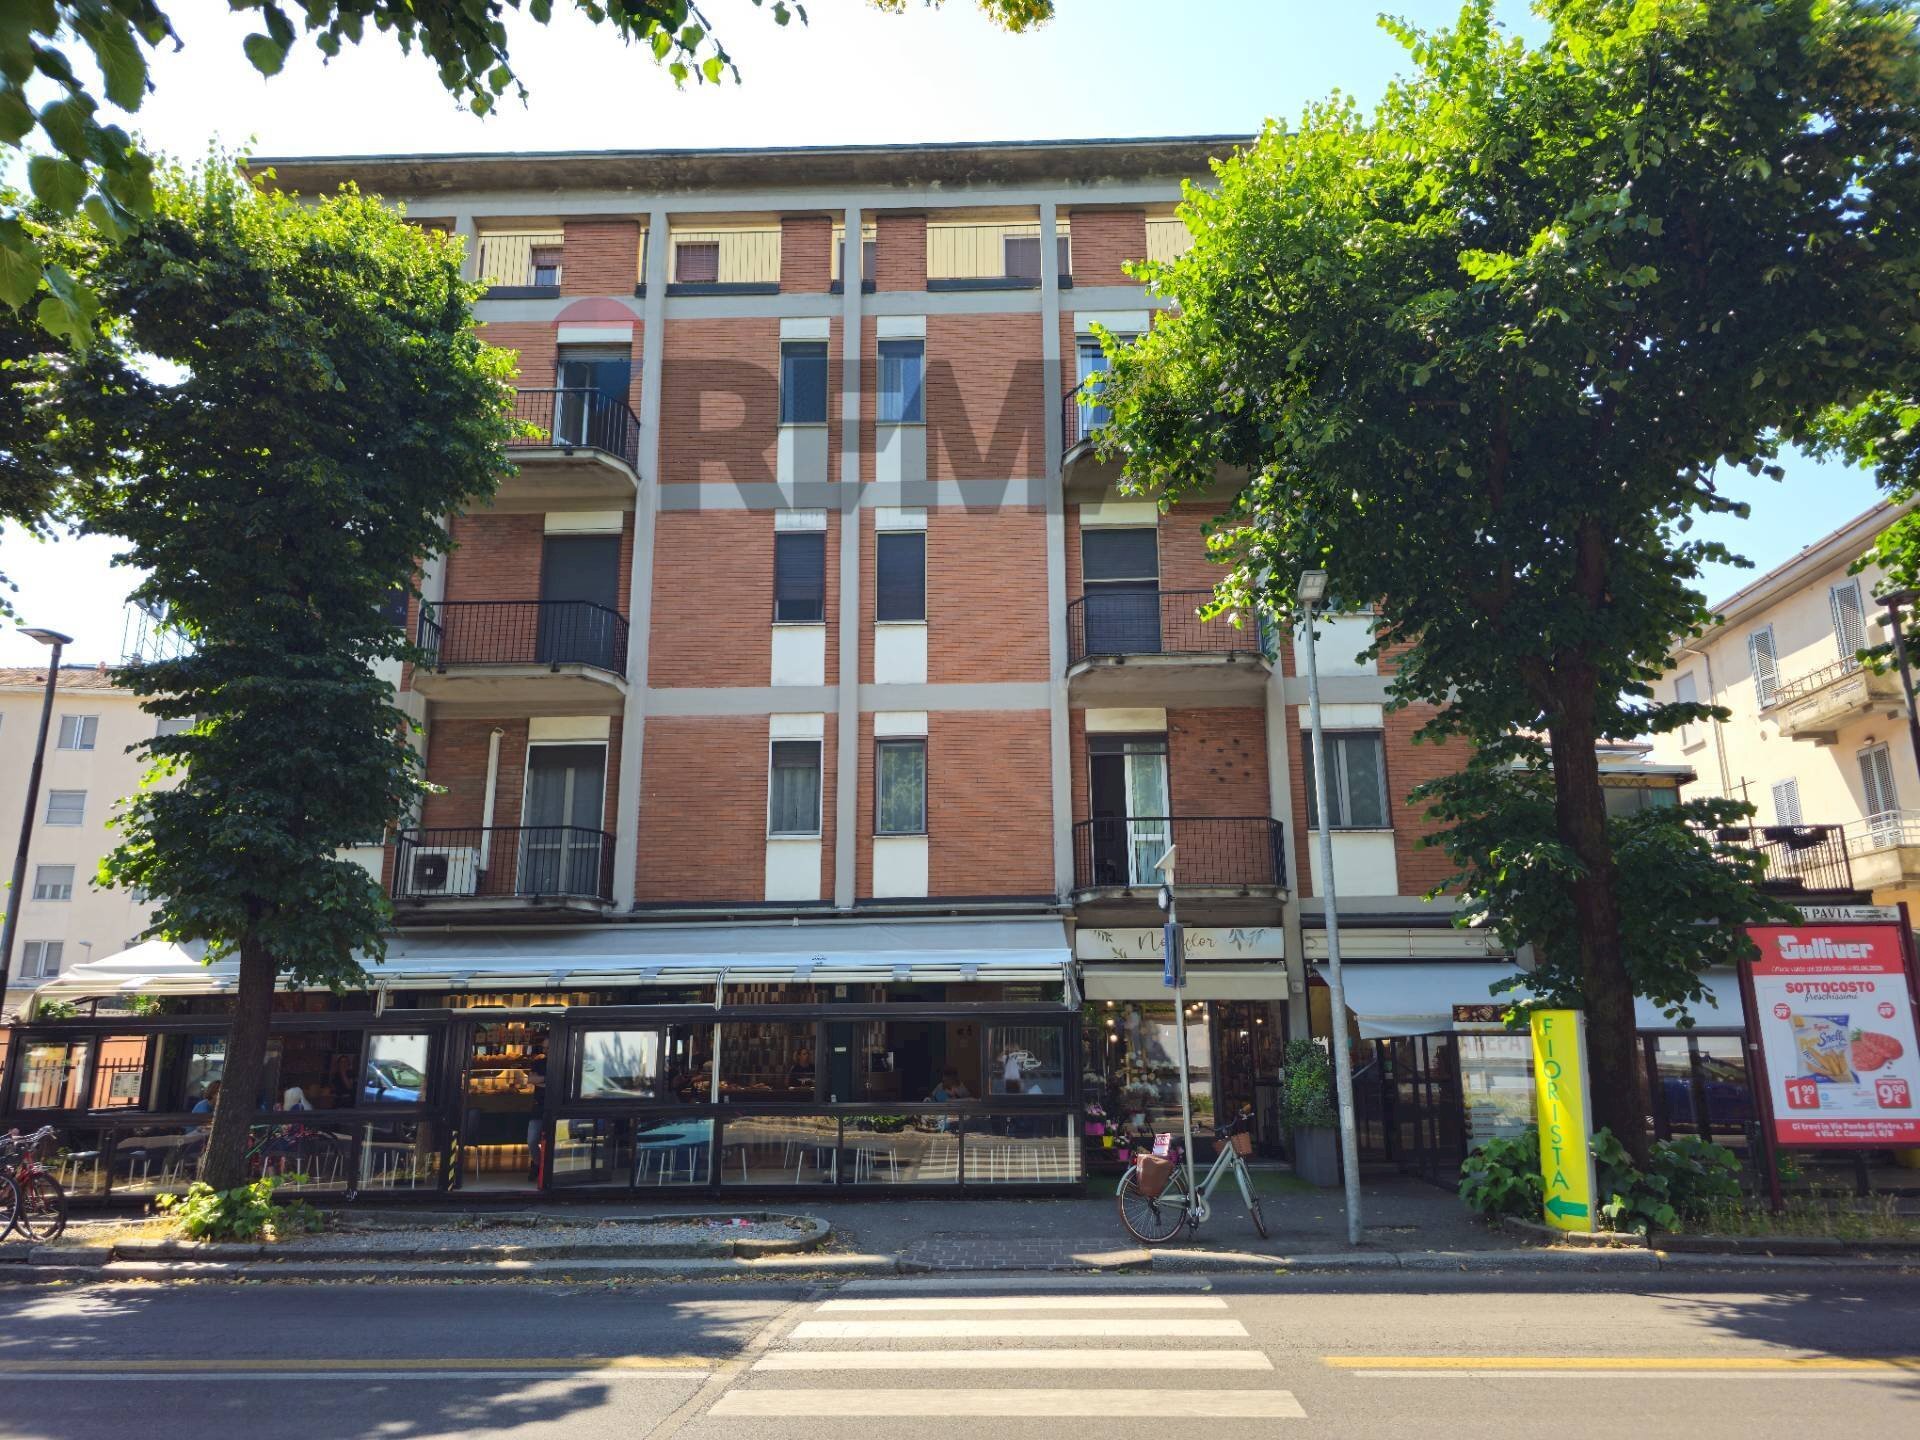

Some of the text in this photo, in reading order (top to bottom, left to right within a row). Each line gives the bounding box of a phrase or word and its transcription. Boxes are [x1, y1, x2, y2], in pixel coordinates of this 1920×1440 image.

[1812, 907, 1851, 919] PAVIA
[1778, 934, 1874, 960] Gulliver
[1785, 981, 1876, 994] SOTTOCOSTO
[1542, 1018, 1570, 1191] FIORISTA
